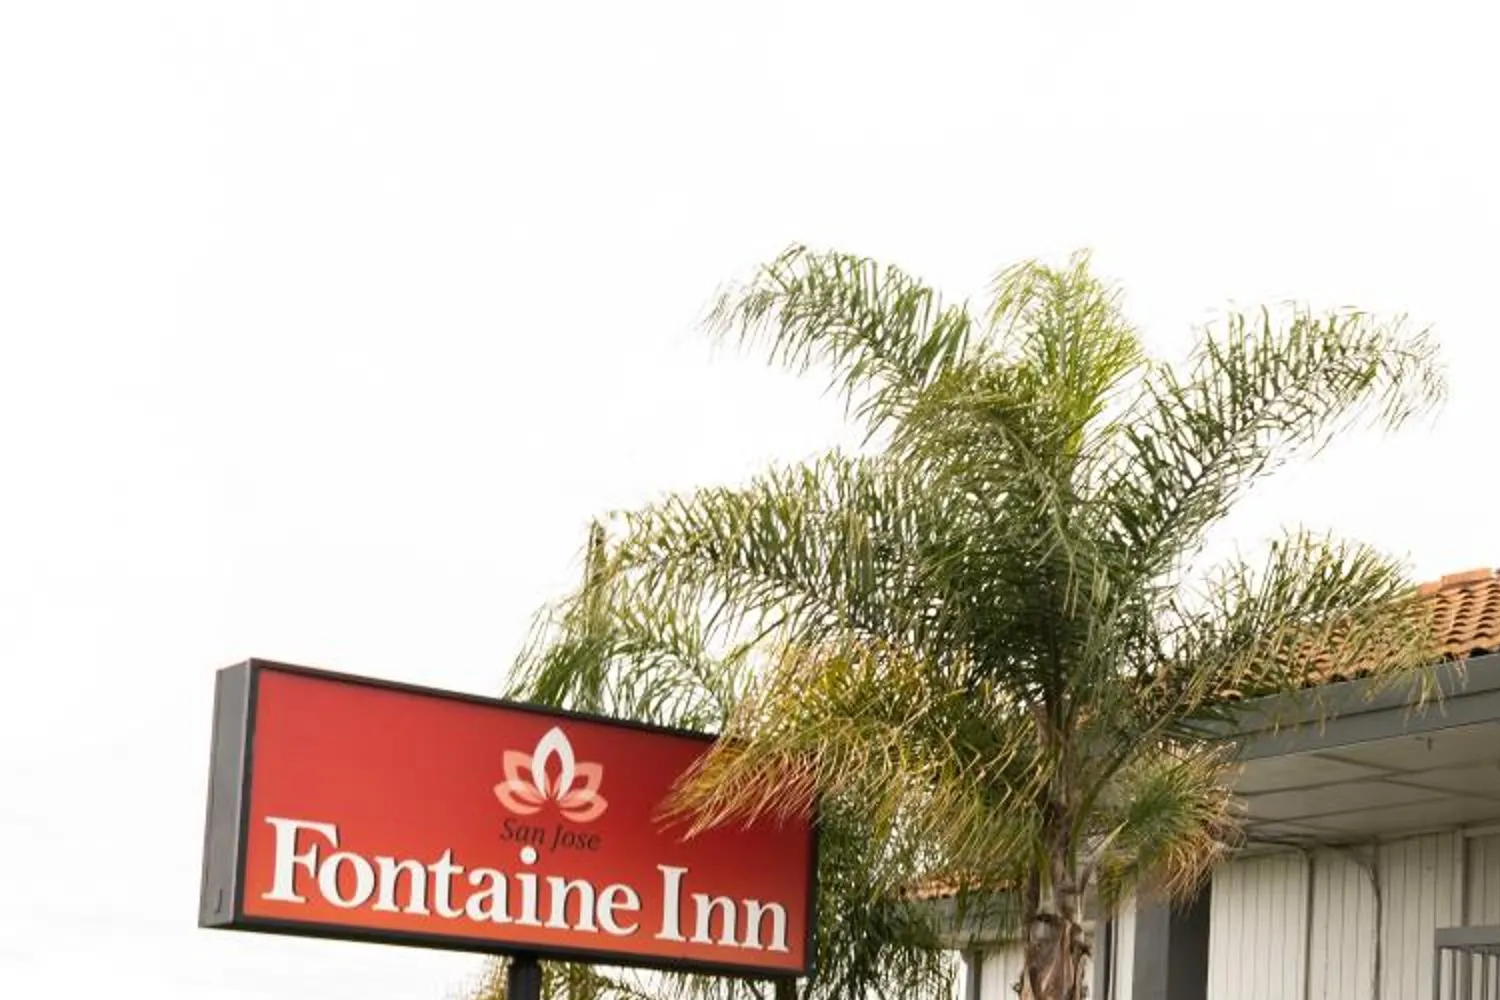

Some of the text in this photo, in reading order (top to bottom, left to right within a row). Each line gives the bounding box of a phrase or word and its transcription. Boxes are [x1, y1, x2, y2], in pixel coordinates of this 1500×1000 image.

[500, 818, 602, 853] San Jose
[262, 815, 791, 954] Fontaine Inn
